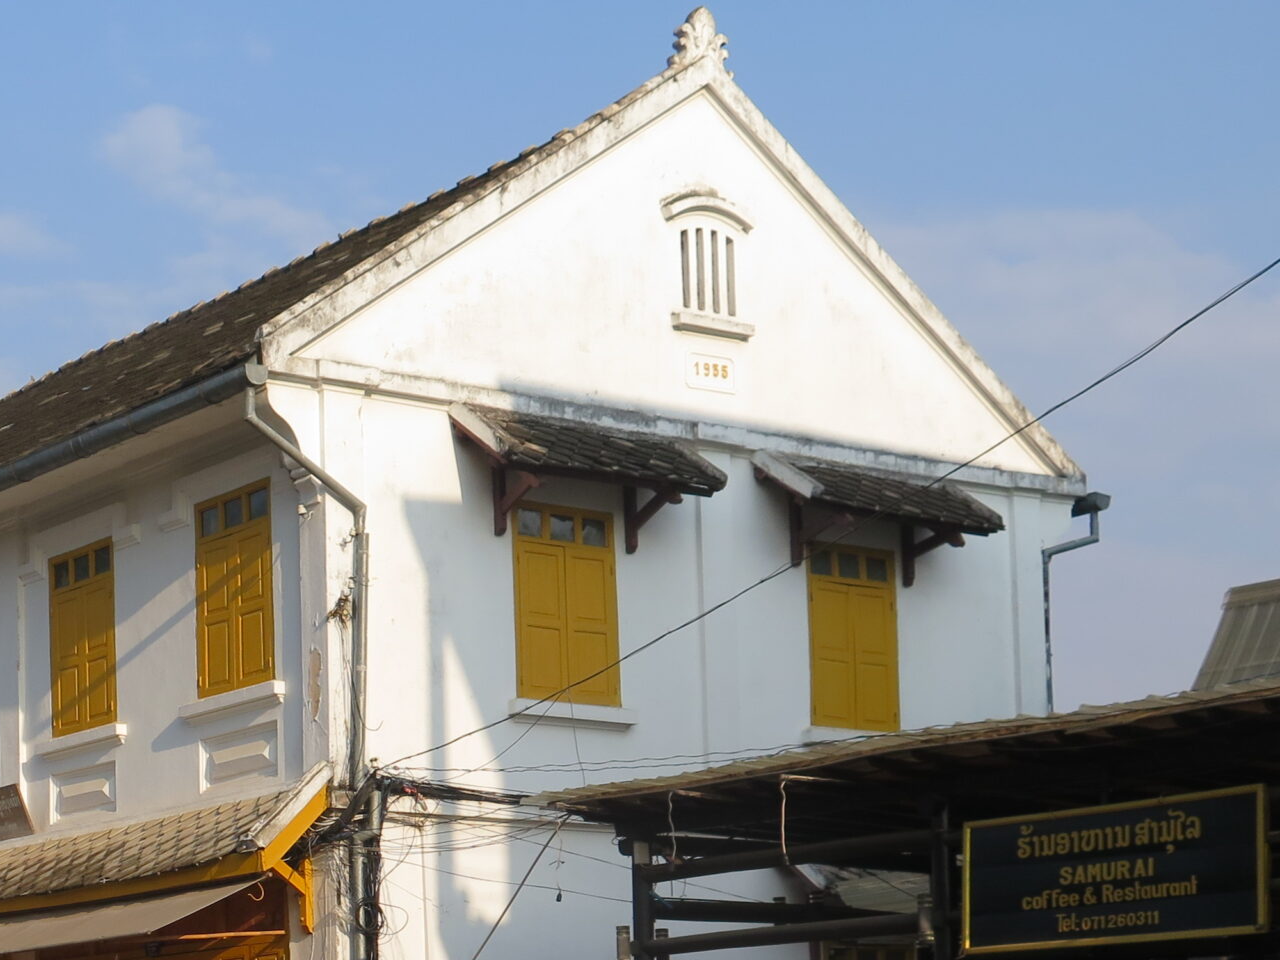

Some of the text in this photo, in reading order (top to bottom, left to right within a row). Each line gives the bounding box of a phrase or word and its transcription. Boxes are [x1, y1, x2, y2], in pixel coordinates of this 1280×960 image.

[1059, 857, 1154, 885] SAMURAI
[1083, 887, 1097, 904] &
[1102, 875, 1198, 904] Restaurant
